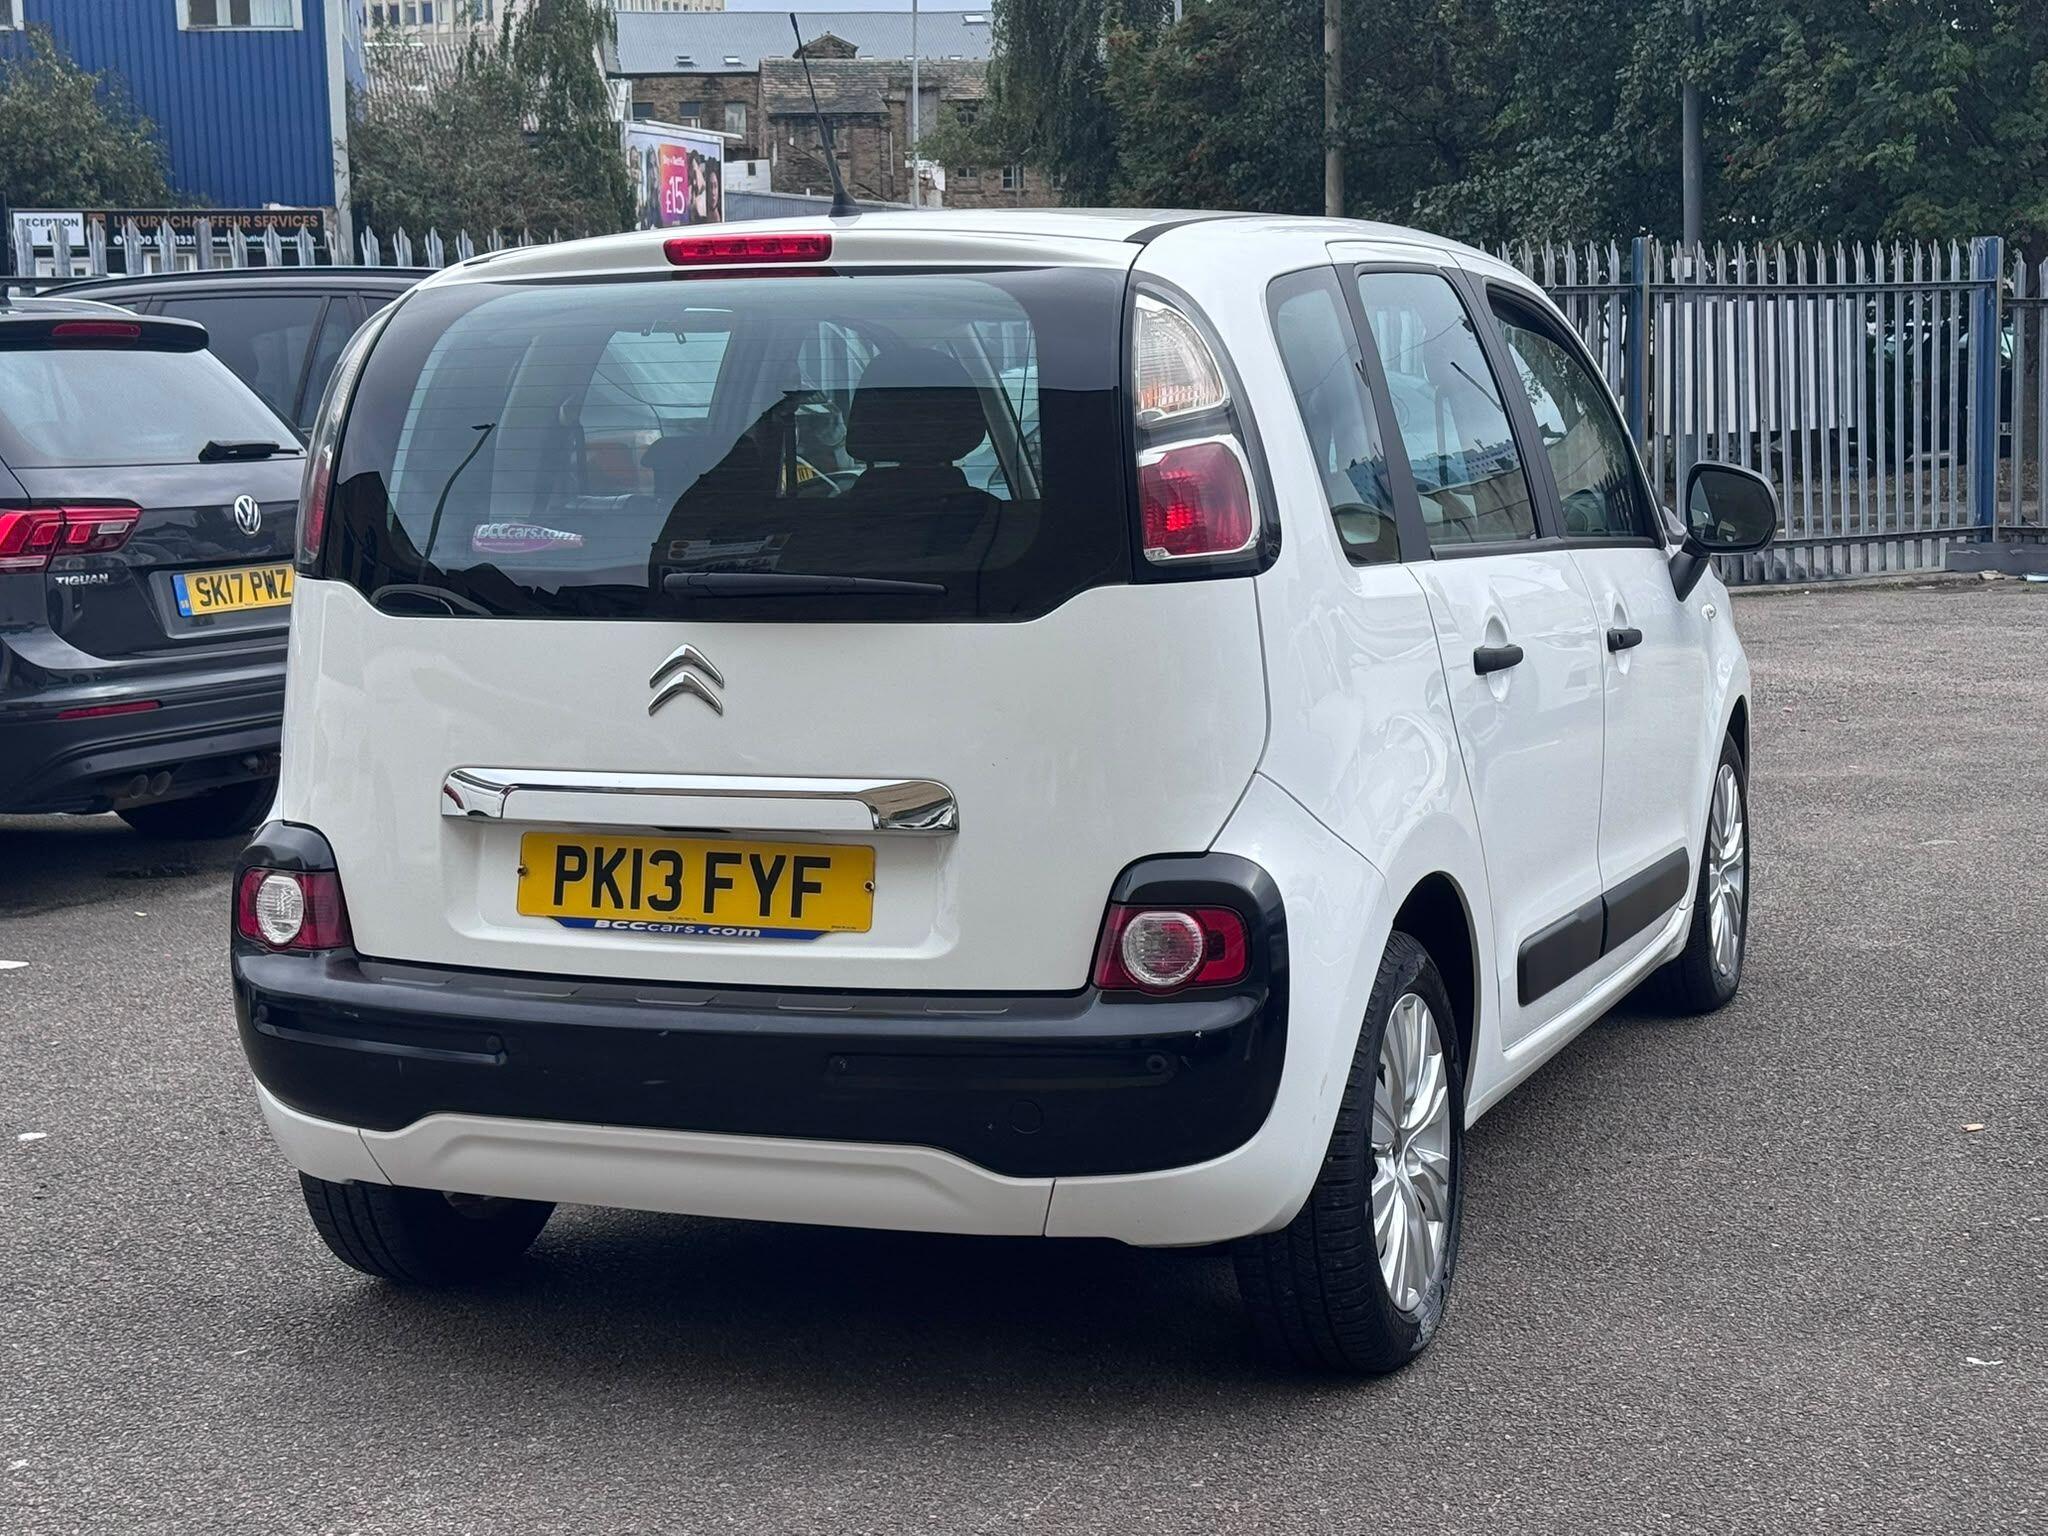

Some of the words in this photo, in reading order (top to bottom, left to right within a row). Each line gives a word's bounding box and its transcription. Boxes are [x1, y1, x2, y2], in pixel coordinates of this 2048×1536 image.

[666, 175, 685, 214] £15
[254, 215, 318, 228] SERVICES
[55, 573, 109, 586] TIGUAN
[195, 573, 243, 607] SK17
[249, 569, 291, 601] PWZ
[553, 844, 683, 912] PK13
[703, 851, 831, 918] FYF
[594, 919, 761, 938] BCCcars.com
